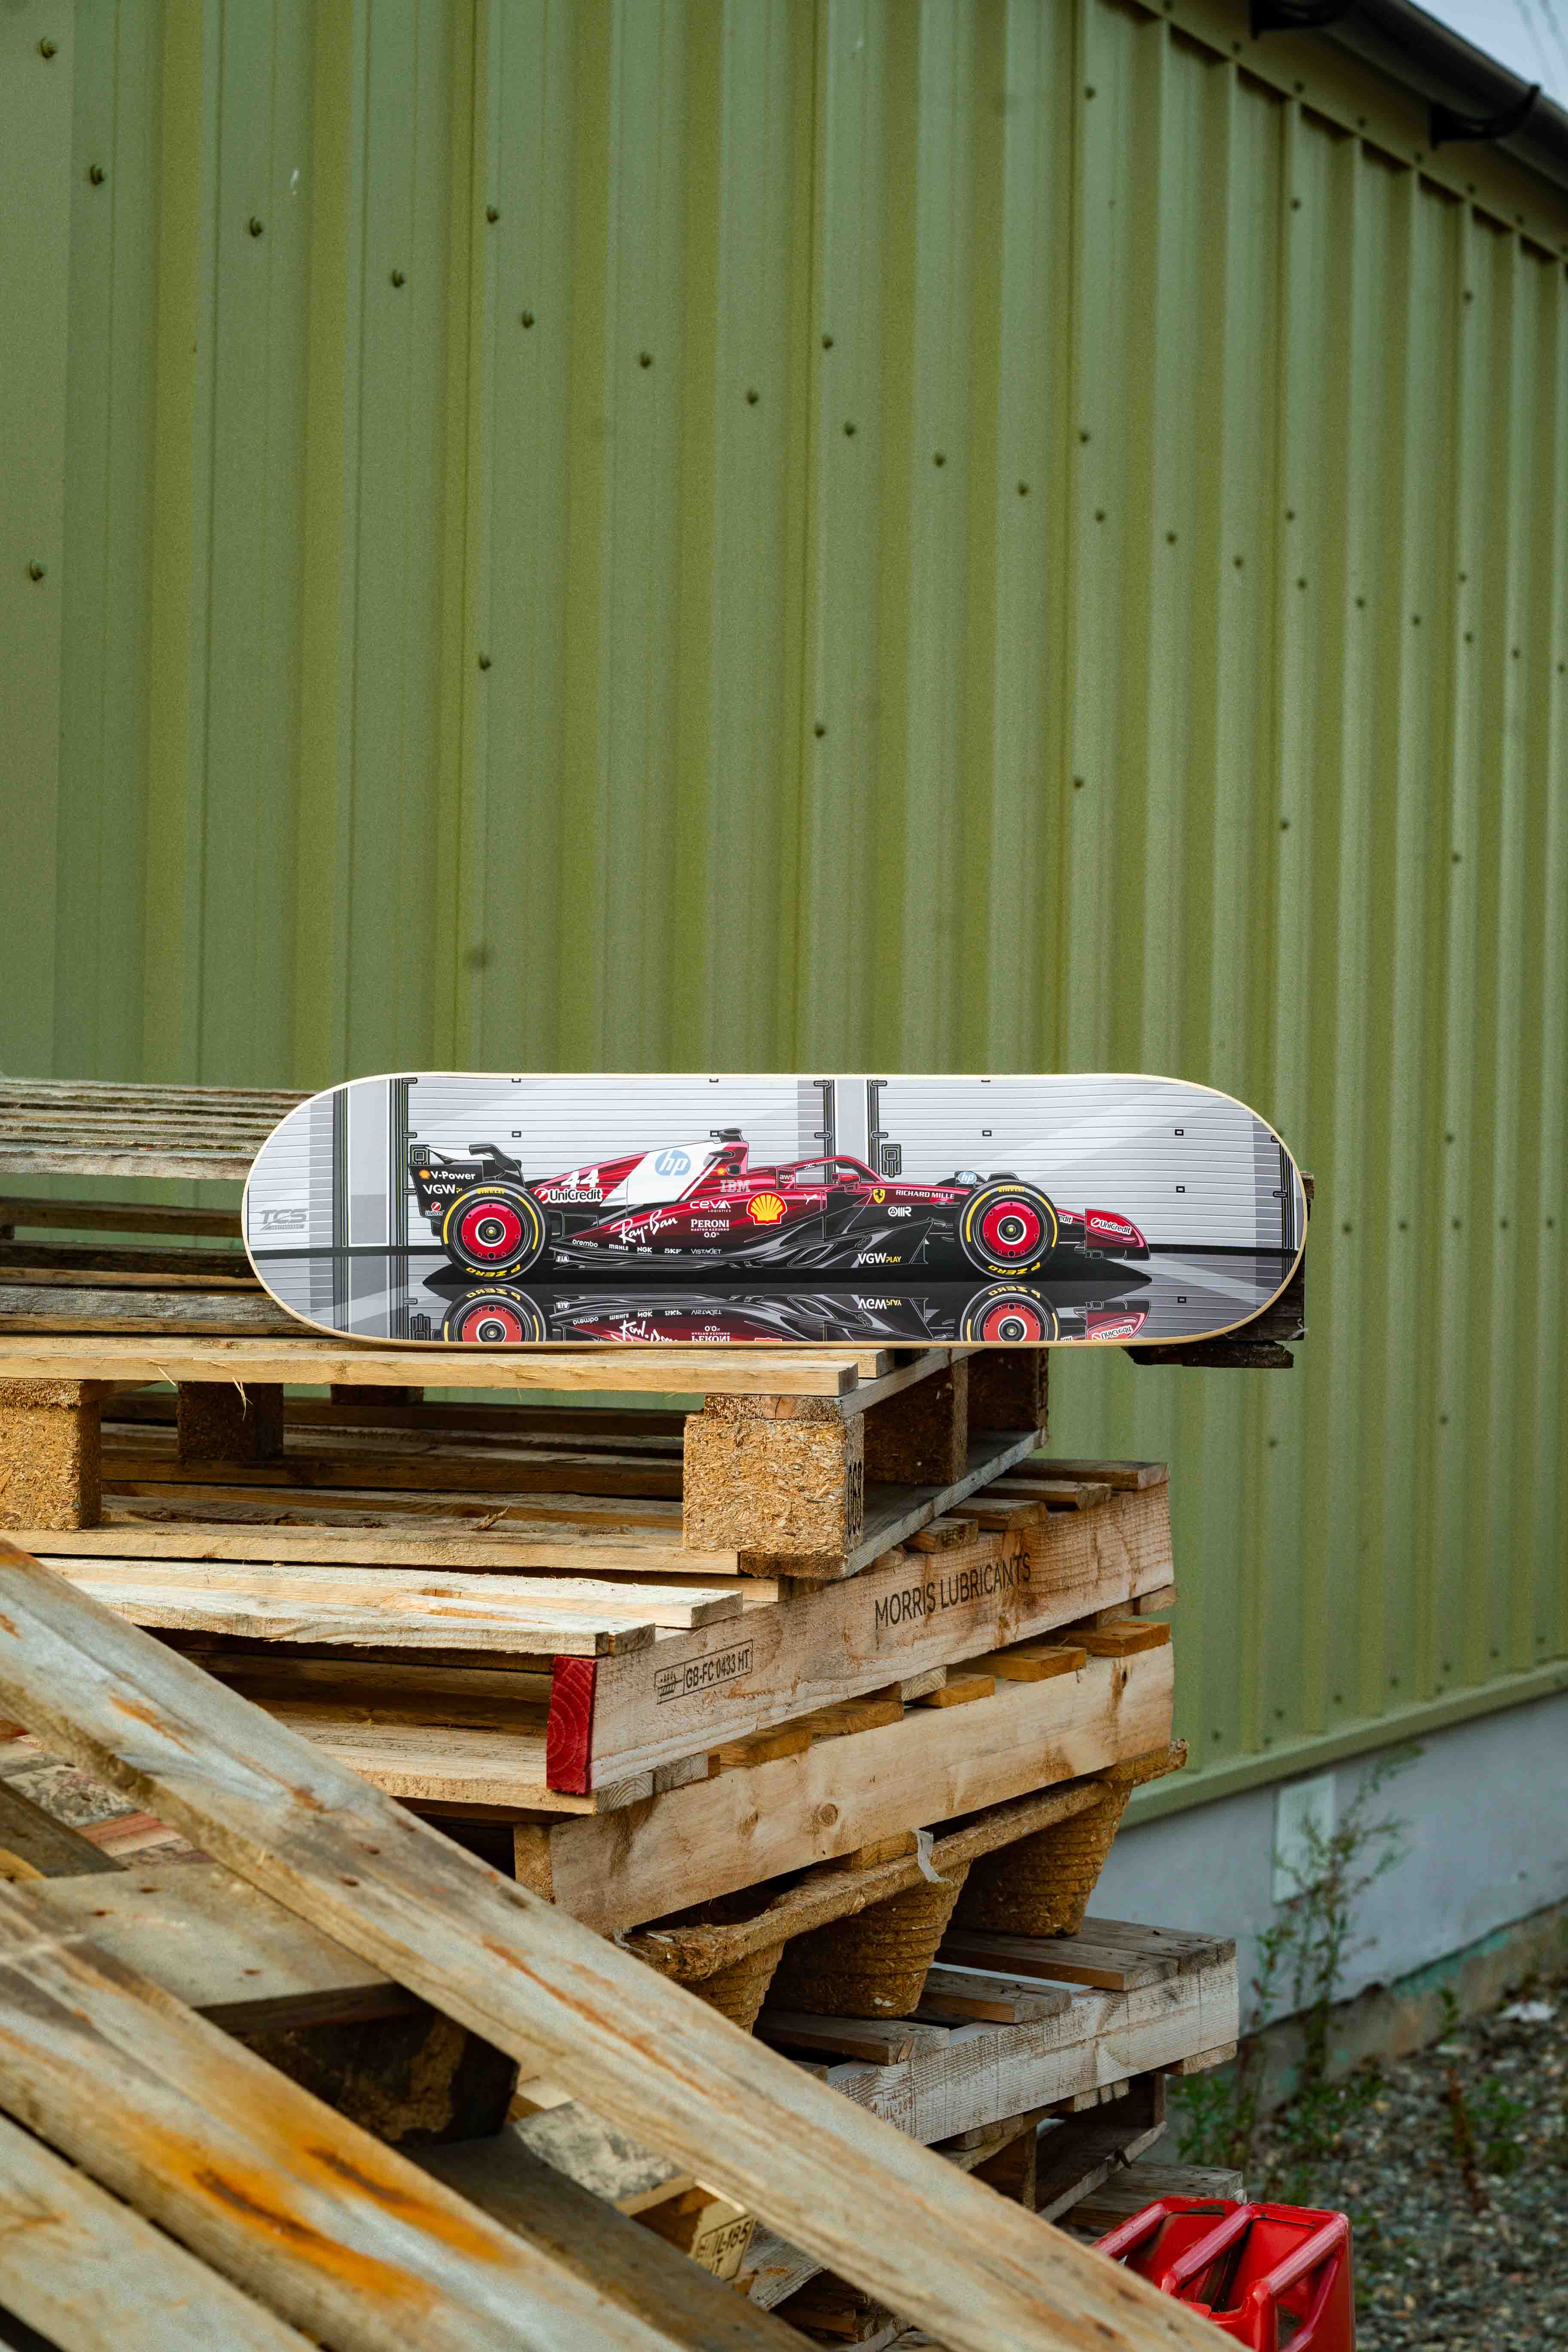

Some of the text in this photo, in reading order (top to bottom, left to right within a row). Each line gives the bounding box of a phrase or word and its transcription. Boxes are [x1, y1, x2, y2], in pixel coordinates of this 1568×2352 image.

[659, 1150, 689, 1175] hp
[430, 1171, 475, 1180] V-Power
[561, 1168, 600, 1188] 44
[961, 1172, 974, 1184] hp
[720, 1180, 750, 1192] IBM
[550, 1189, 601, 1201] UniCredit
[896, 1190, 930, 1198] RICHARD
[260, 1209, 307, 1224] TCS
[691, 1219, 730, 1228] PERONI
[1100, 1220, 1131, 1234] UniCredit
[572, 1239, 598, 1248] brembo
[466, 1267, 507, 1277] ZERO
[875, 1552, 1031, 1629] MORRIS LUBRICANTS
[686, 1648, 750, 1689] GB-FC 0433 HT
